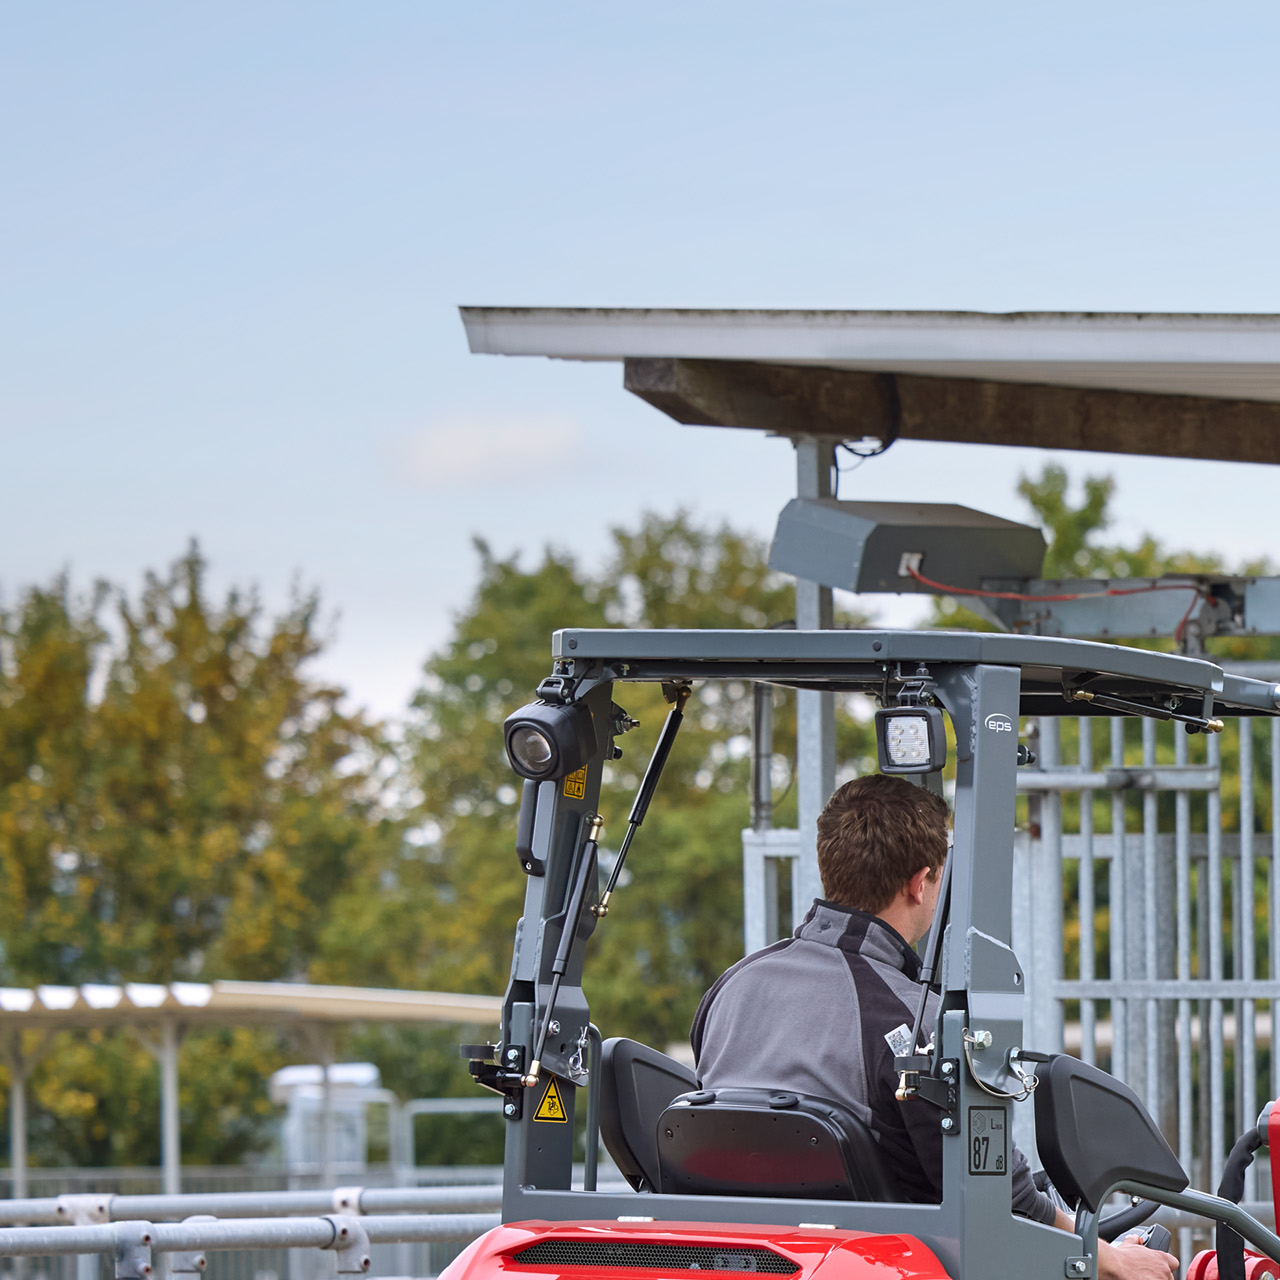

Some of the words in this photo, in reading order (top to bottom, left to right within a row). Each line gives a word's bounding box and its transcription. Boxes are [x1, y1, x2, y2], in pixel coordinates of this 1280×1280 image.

[988, 720, 1012, 733] eps
[973, 1136, 990, 1170] 87
[995, 1155, 1004, 1170] dB
